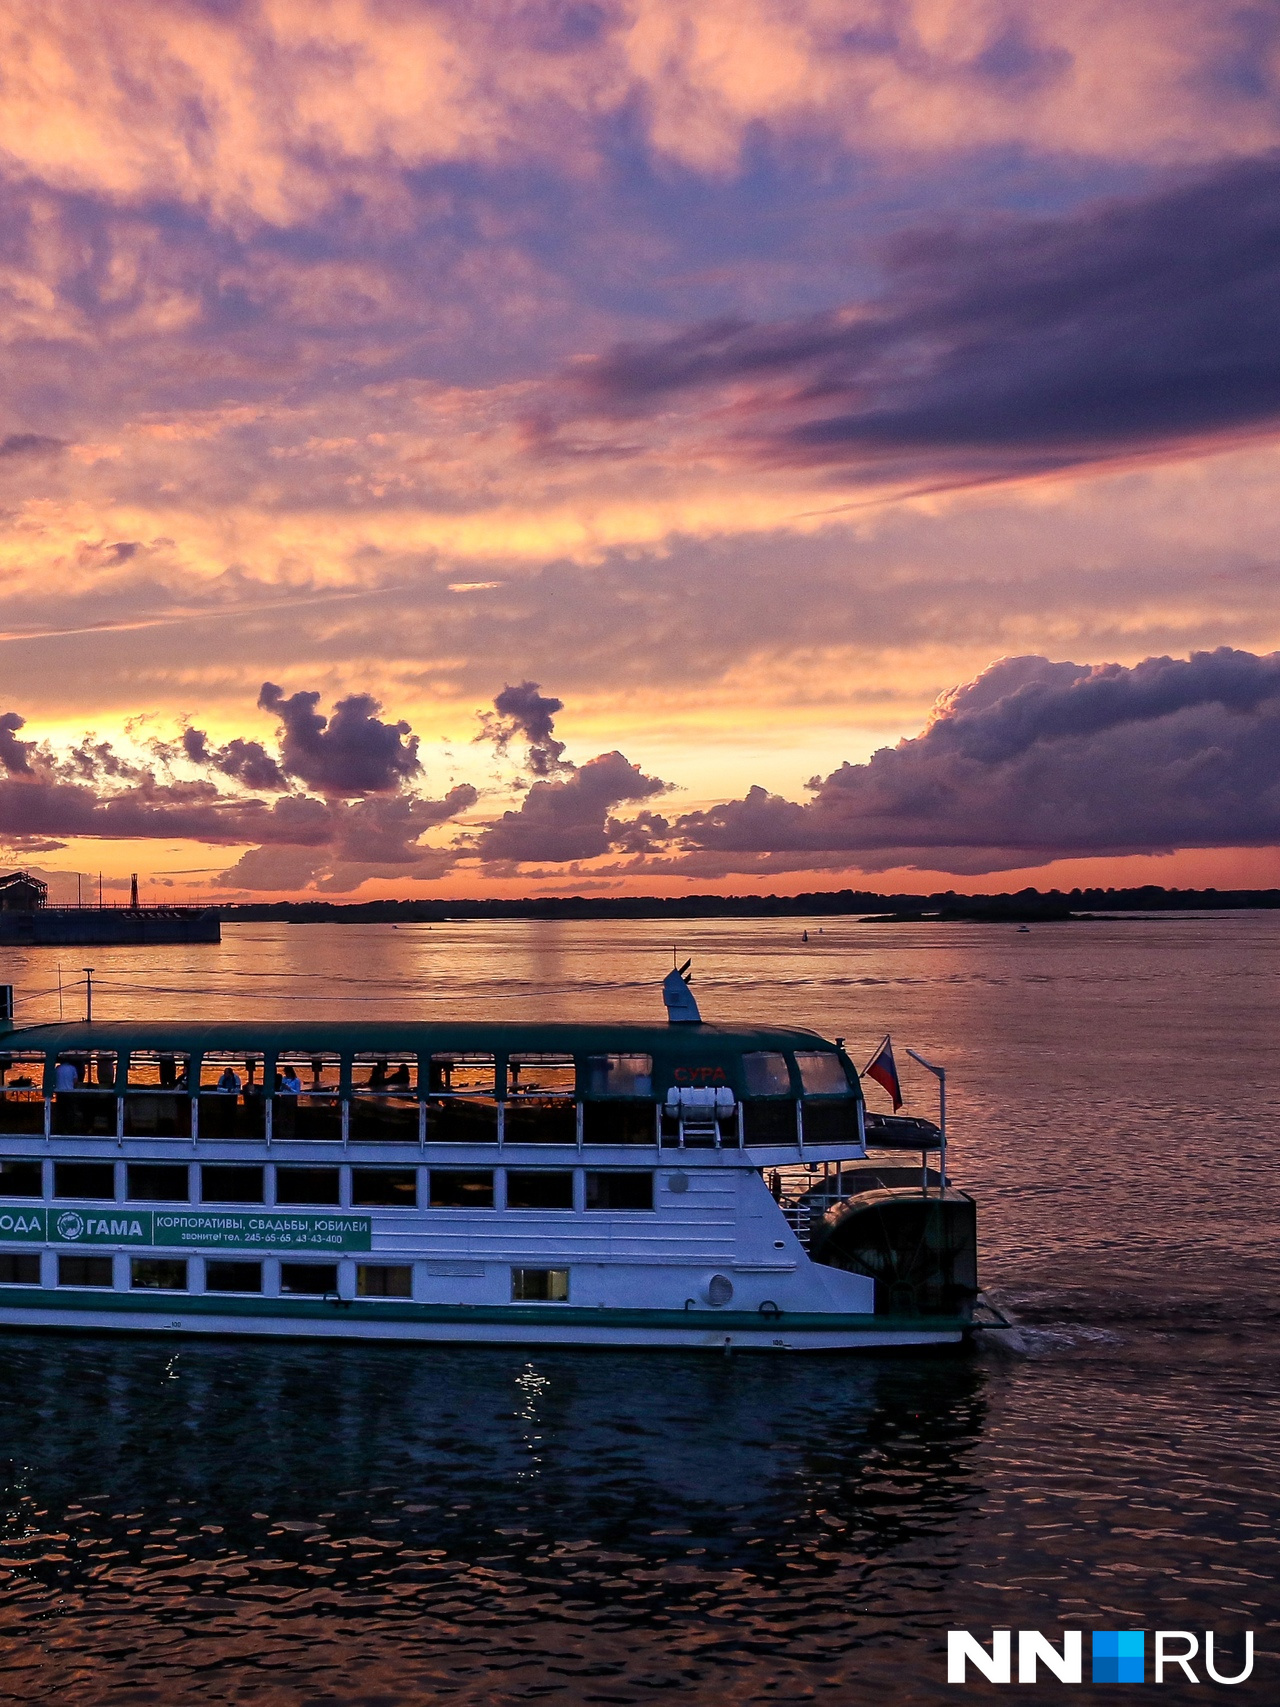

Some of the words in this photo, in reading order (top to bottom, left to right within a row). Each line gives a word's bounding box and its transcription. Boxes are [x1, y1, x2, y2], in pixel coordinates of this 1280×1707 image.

[673, 1066, 727, 1081] СУРА
[86, 1219, 143, 1236] ГАМА
[156, 1216, 246, 1230] КОРПОРАТИВЫ,
[248, 1219, 312, 1232] СВАДЬБЫ,
[314, 1220, 368, 1232] ЮБИЛЕИ
[181, 1232, 222, 1241] звоните!
[223, 1233, 243, 1242] тел.
[296, 1234, 343, 1244] 43-43-400
